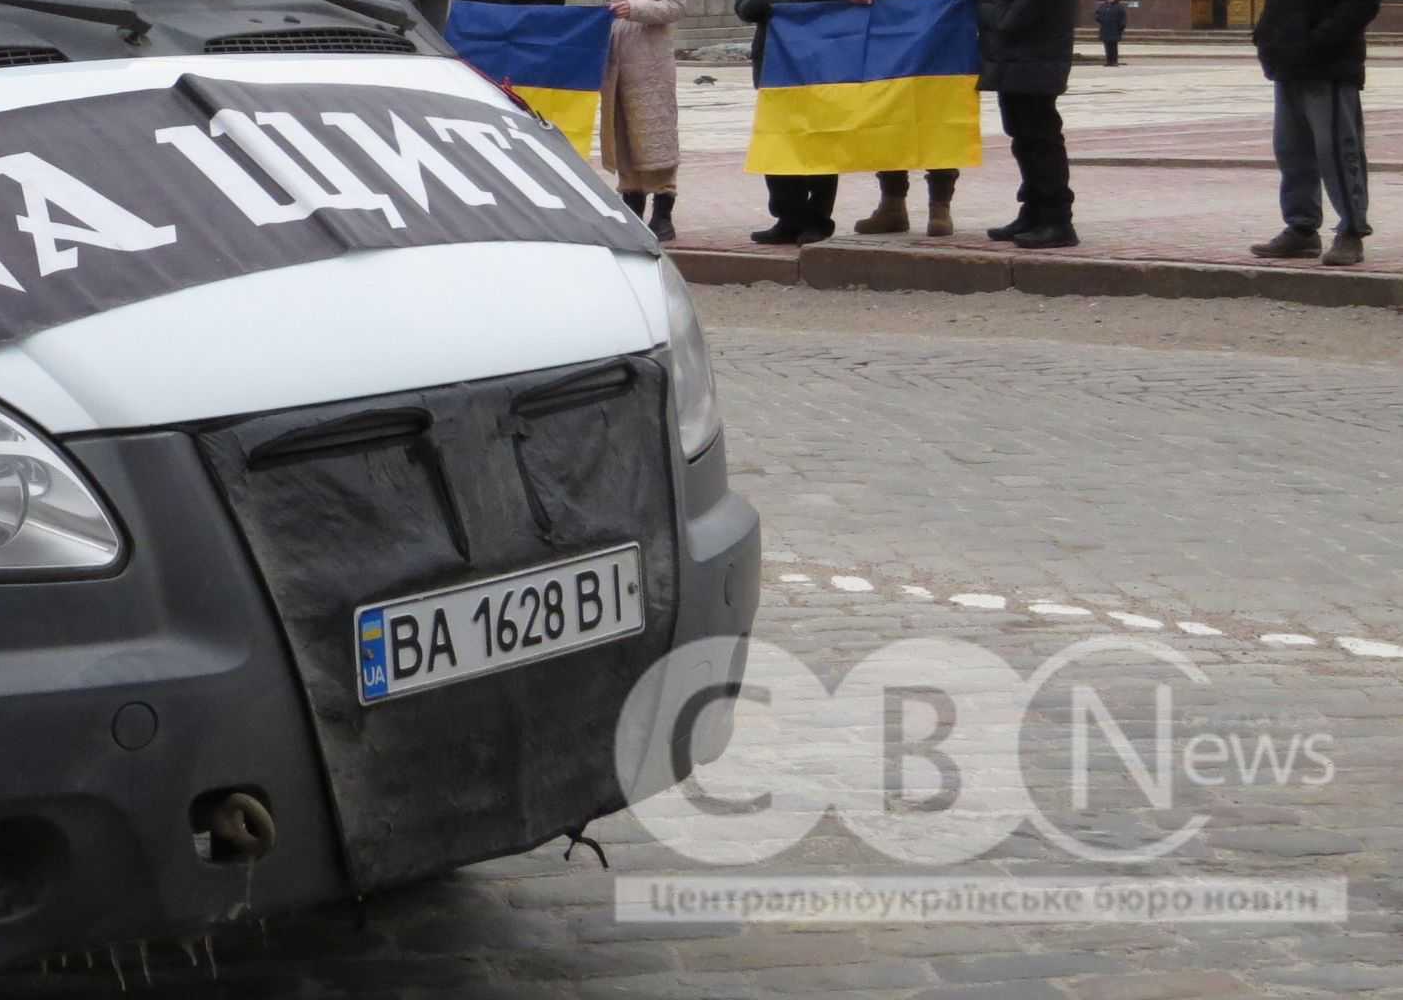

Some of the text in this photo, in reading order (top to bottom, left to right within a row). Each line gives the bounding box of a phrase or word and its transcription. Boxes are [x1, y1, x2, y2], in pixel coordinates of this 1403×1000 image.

[389, 608, 457, 680] BA
[472, 579, 565, 657] 1628
[363, 666, 386, 687] UA
